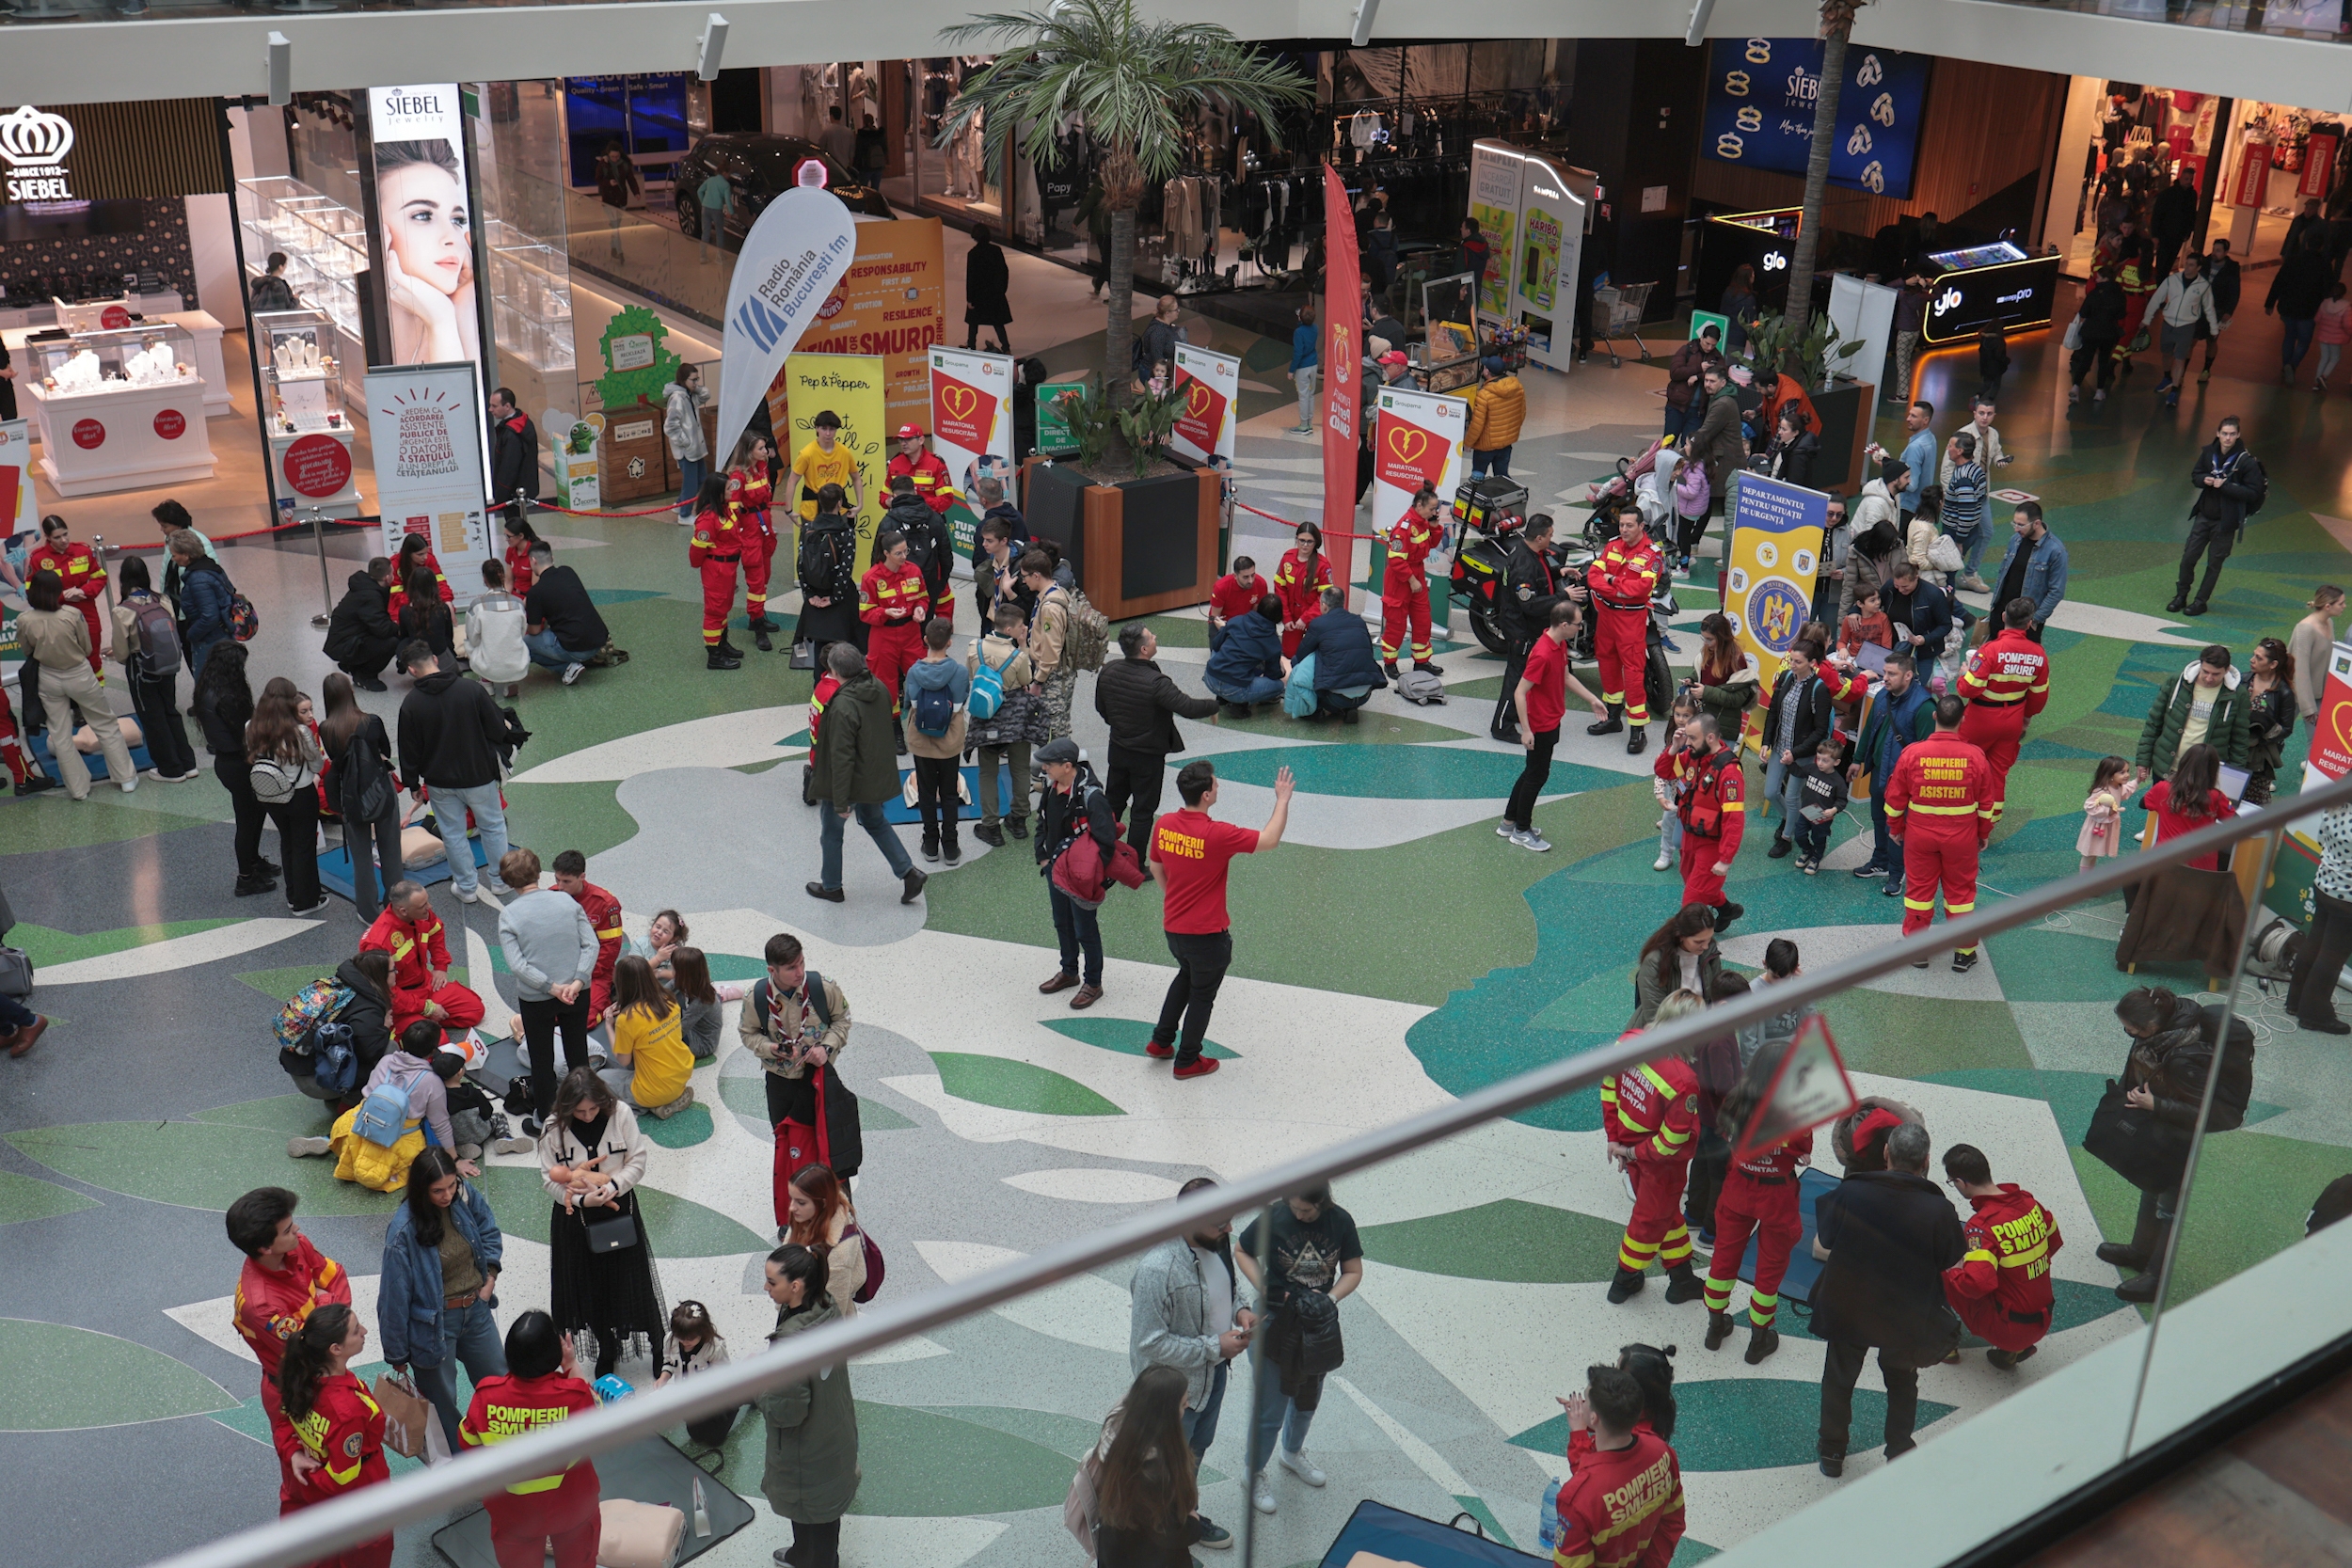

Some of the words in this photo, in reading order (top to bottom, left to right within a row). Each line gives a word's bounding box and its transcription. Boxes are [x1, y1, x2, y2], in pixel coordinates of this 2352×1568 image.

[571, 87, 595, 95] Quality
[1786, 75, 1821, 101] SIEB
[386, 96, 443, 116] SIEBEL
[1785, 97, 1818, 110] Jewel
[1779, 119, 1794, 135] More
[8, 179, 72, 200] SIEBEL
[1047, 182, 1072, 194] Papy
[1480, 182, 1511, 198] GRATUIT
[1530, 217, 1558, 236] HARIBO
[1481, 230, 1502, 242] HARIBO
[853, 252, 893, 261] OMMUNICATION
[1763, 250, 1787, 271] glo
[783, 251, 834, 318] București
[829, 234, 849, 254] fm
[851, 261, 927, 278] RESPONSABILITY
[758, 259, 790, 298] Radio
[771, 250, 817, 308] România
[882, 277, 898, 286] FIRST
[2015, 288, 2032, 303] pro
[853, 300, 882, 310] DEVOTION
[883, 306, 932, 322] RESILIENCE
[830, 320, 857, 331] HUMANITY
[860, 325, 935, 355] SMURD
[945, 359, 969, 368] Groupama
[1186, 356, 1206, 367] Groupama
[896, 369, 920, 378] GROWTH
[800, 375, 819, 390] Pep
[821, 376, 829, 387] &
[829, 374, 870, 391] Pepper
[1395, 400, 1422, 409] Groupama
[155, 414, 183, 425] Giveaway
[400, 414, 444, 423] ACORDAREA
[943, 420, 976, 430] MARATONUL
[73, 423, 102, 435] Giveaway
[400, 430, 435, 438] PUBLICE
[399, 446, 407, 455] O
[411, 442, 453, 454] DATORIE
[399, 454, 405, 463] A
[408, 451, 453, 463] STATULUI
[421, 460, 445, 469] DREPT
[1388, 462, 1423, 474] MARATONUL
[1742, 486, 1805, 510] DEPARTAMENTUL
[1740, 506, 1749, 515] DE
[1741, 496, 1770, 510] PENTRU
[1771, 505, 1803, 519] SITUAȚII
[954, 520, 967, 532] TU
[963, 543, 976, 551] VIA
[1997, 652, 2044, 667] POMPIERII
[2003, 664, 2036, 676] SMURD
[1919, 757, 1968, 768] POMPIERII
[2323, 748, 2352, 765] MARAT
[1923, 768, 1963, 781] SMURD
[1807, 775, 1818, 784] THE
[1818, 780, 1833, 791] BEST
[361, 777, 385, 816] NIKE
[1919, 785, 1967, 799] ASISTENT
[1158, 828, 1205, 850] POMPIERII
[1158, 839, 1205, 859] SMURD
[649, 1026, 661, 1036] PEER
[1625, 1065, 1655, 1096] MPIERII
[1621, 1085, 1646, 1115] LUNTAR
[1739, 1161, 1779, 1173] OLUNTAR
[2000, 1222, 2047, 1255] SMUR
[487, 1404, 569, 1423] POMPIERII
[383, 1414, 408, 1454] RA
[1602, 1451, 1670, 1512] POMPIERII
[1611, 1471, 1672, 1525] SMURD
